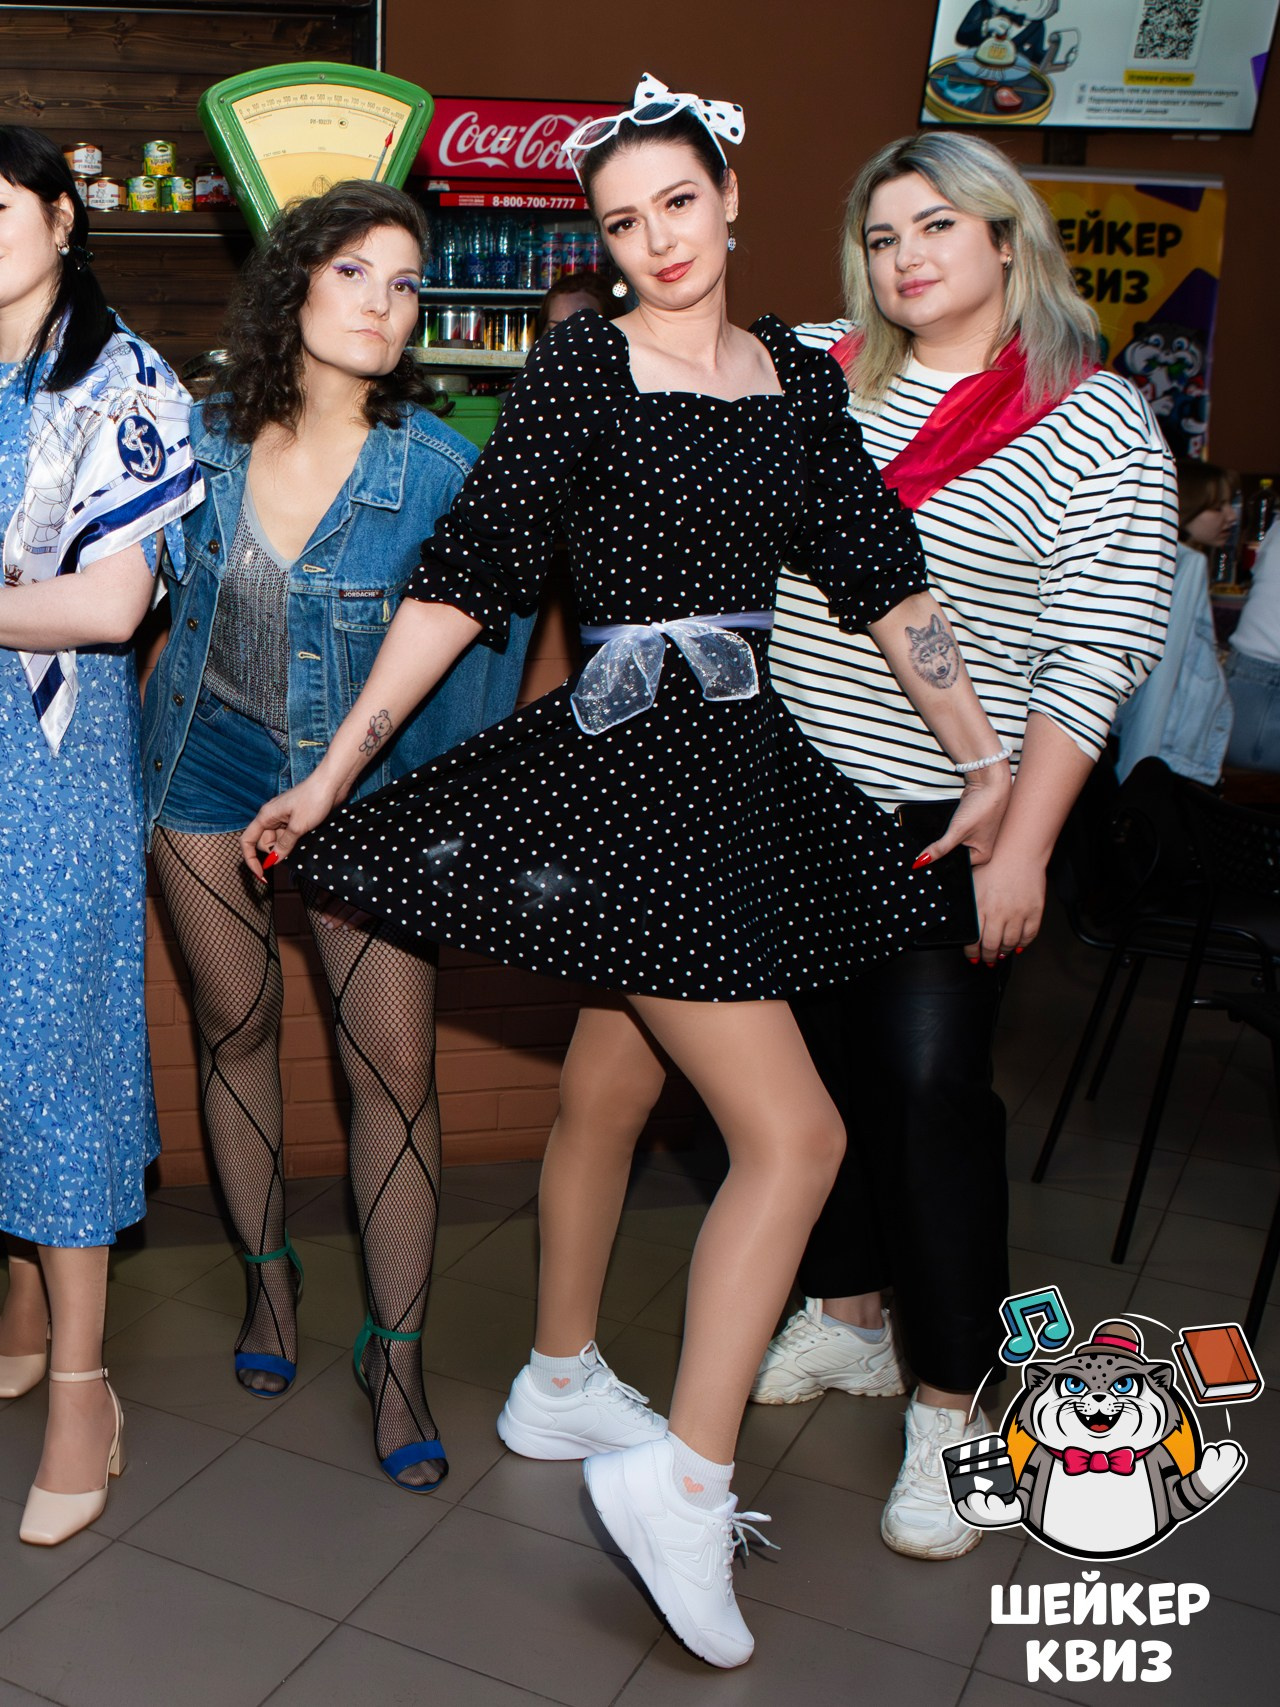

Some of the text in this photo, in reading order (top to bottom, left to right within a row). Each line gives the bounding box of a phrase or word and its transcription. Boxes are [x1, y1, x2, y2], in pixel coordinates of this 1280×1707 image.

[492, 196, 576, 209] 8-800-700-7777
[1057, 209, 1183, 258] ЕЙКЕР
[1071, 267, 1149, 304] ВИЗ
